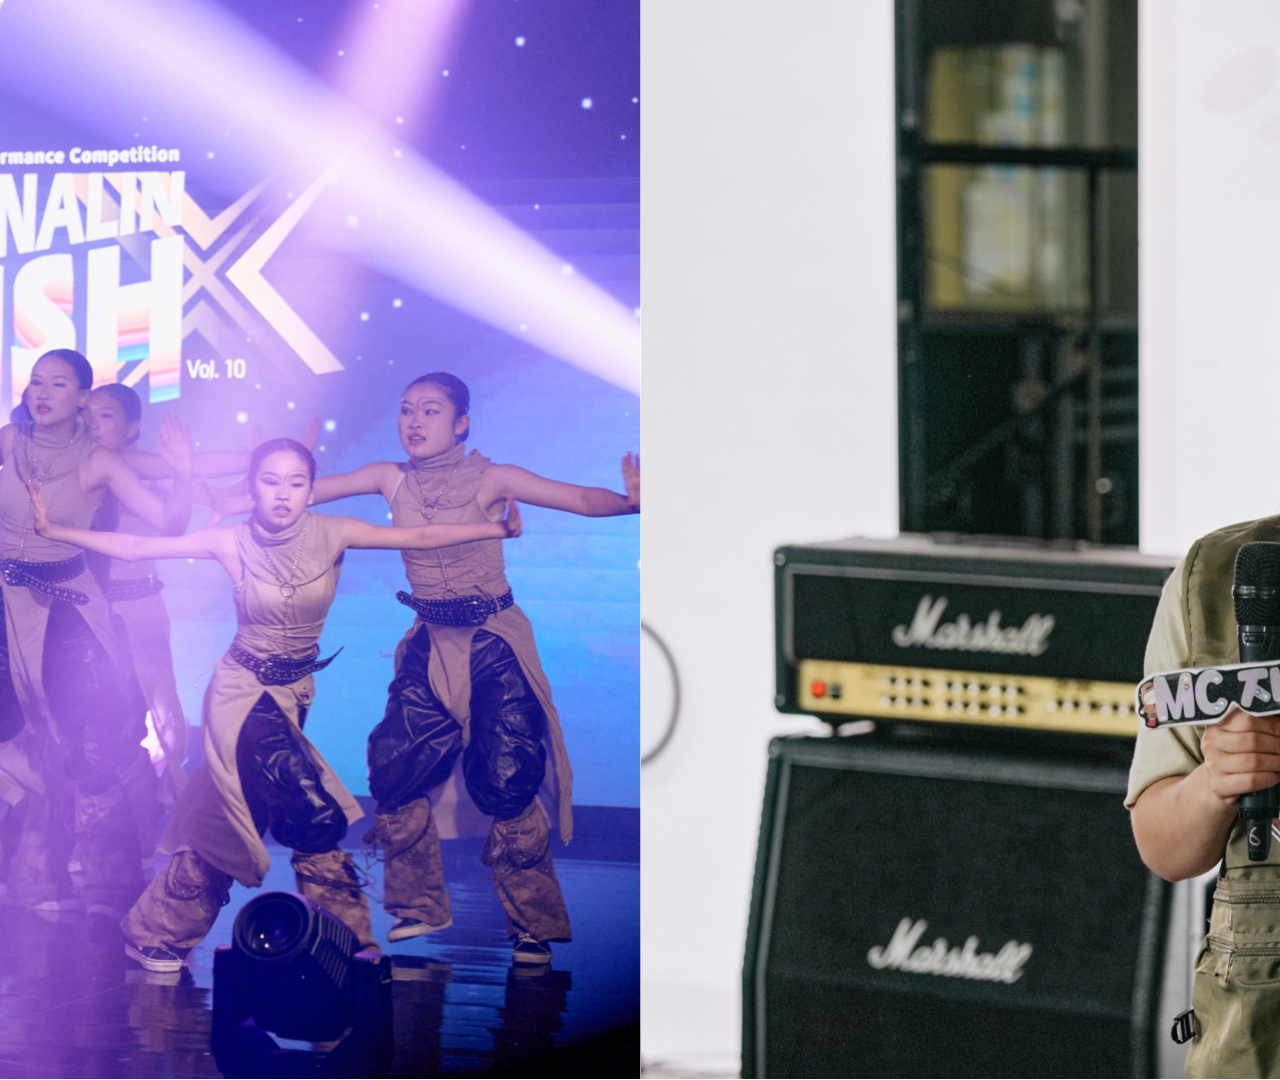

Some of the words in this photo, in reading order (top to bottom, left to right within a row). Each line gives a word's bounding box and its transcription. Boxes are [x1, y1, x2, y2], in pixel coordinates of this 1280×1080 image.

[69, 145, 181, 167] Competition
[186, 360, 220, 379] Vol.
[225, 358, 247, 379] 10
[892, 594, 1056, 657] Marshall
[1153, 669, 1227, 721] MC
[1248, 826, 1261, 847] 6
[868, 918, 1033, 985] Marshall
